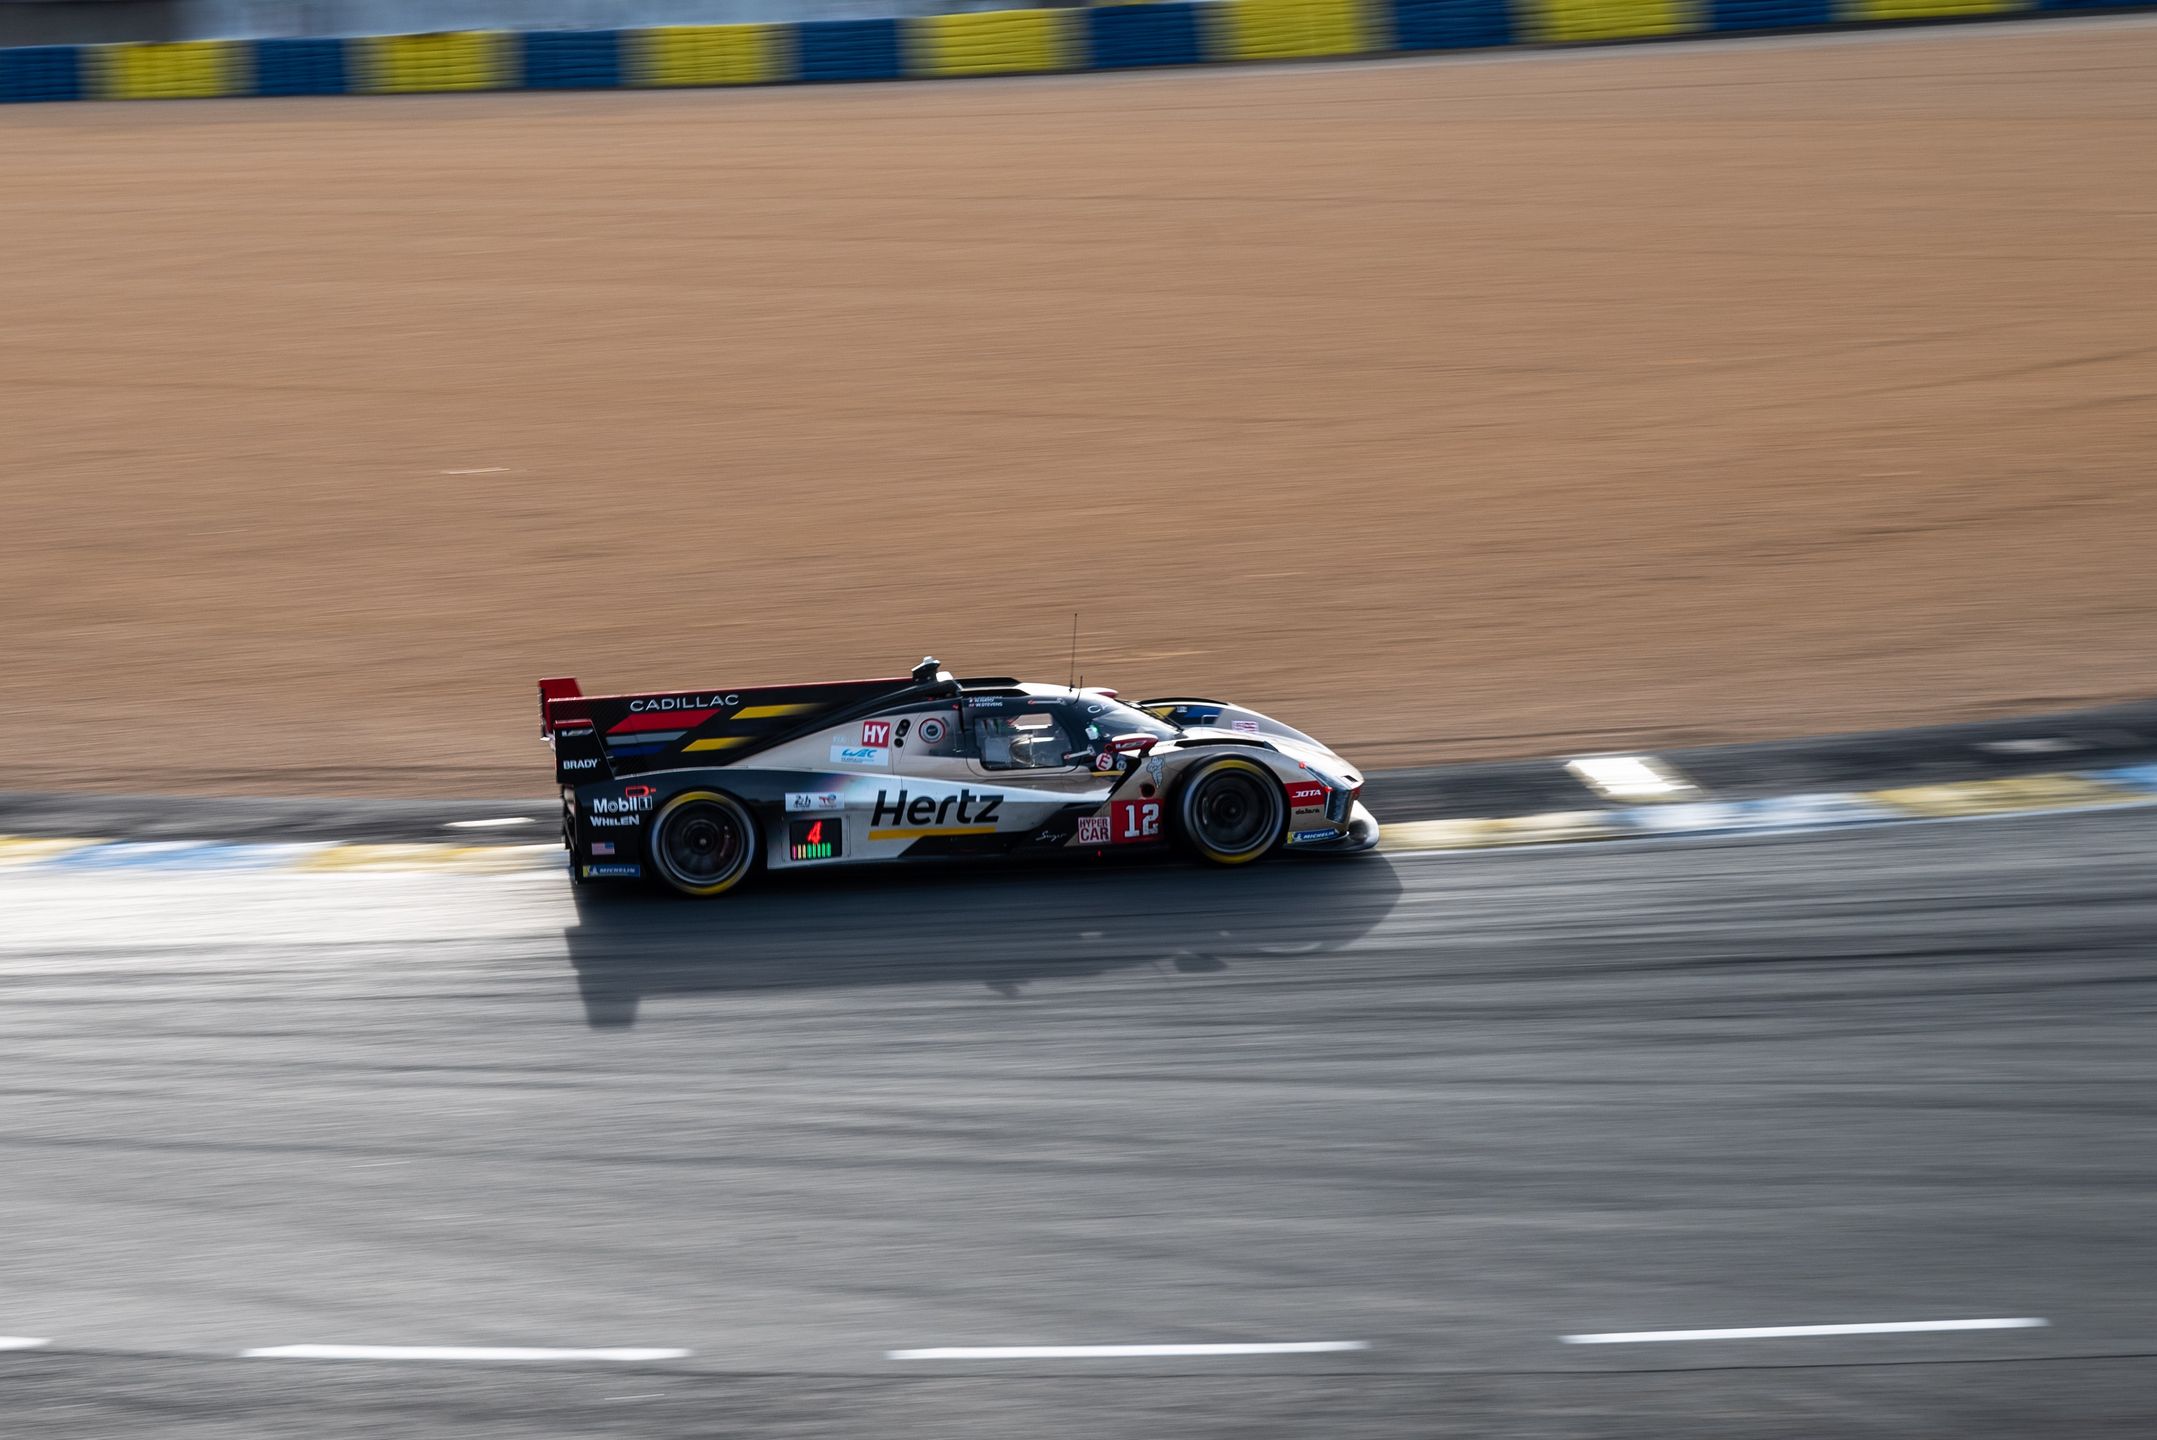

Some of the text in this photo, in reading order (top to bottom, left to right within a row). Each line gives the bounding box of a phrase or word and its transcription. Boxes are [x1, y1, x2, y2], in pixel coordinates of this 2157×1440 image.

[630, 694, 739, 712] CADILLAC
[863, 725, 888, 743] HY
[563, 758, 598, 770] BRADY
[1098, 753, 1111, 769] E
[1292, 789, 1322, 798] JOTA
[593, 795, 637, 813] Mobil
[871, 789, 1004, 827] Hertz
[590, 814, 640, 827] WHELEN
[1080, 818, 1108, 828] HYPER
[1124, 803, 1160, 838] 12
[807, 820, 823, 845] 4
[1080, 828, 1110, 841] CAR
